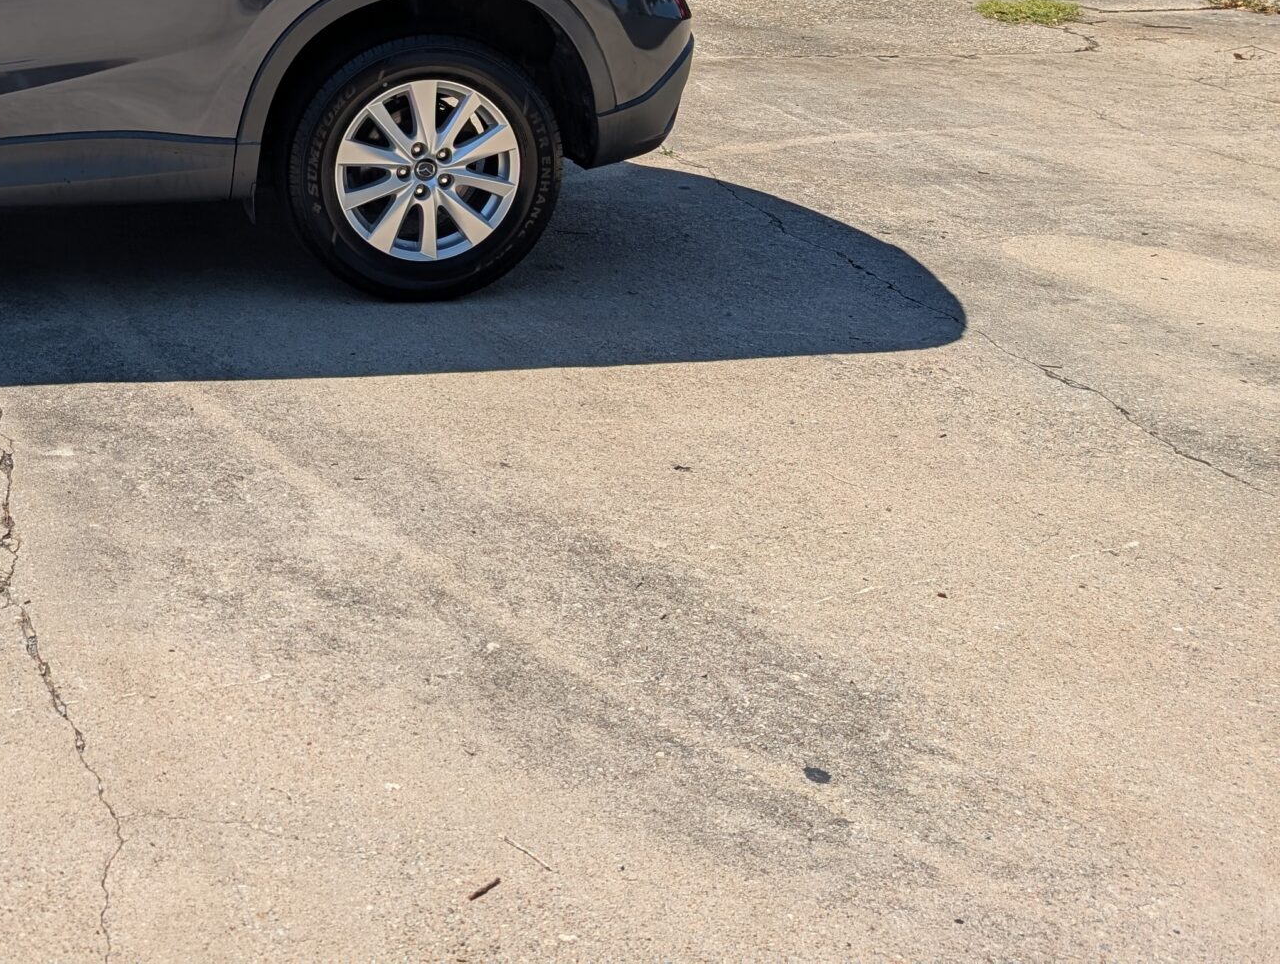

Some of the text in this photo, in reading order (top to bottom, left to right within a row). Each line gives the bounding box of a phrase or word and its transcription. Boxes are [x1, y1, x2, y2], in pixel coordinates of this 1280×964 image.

[307, 85, 356, 199] SUMITOMO
[517, 110, 552, 238] HTR ENHANCE
